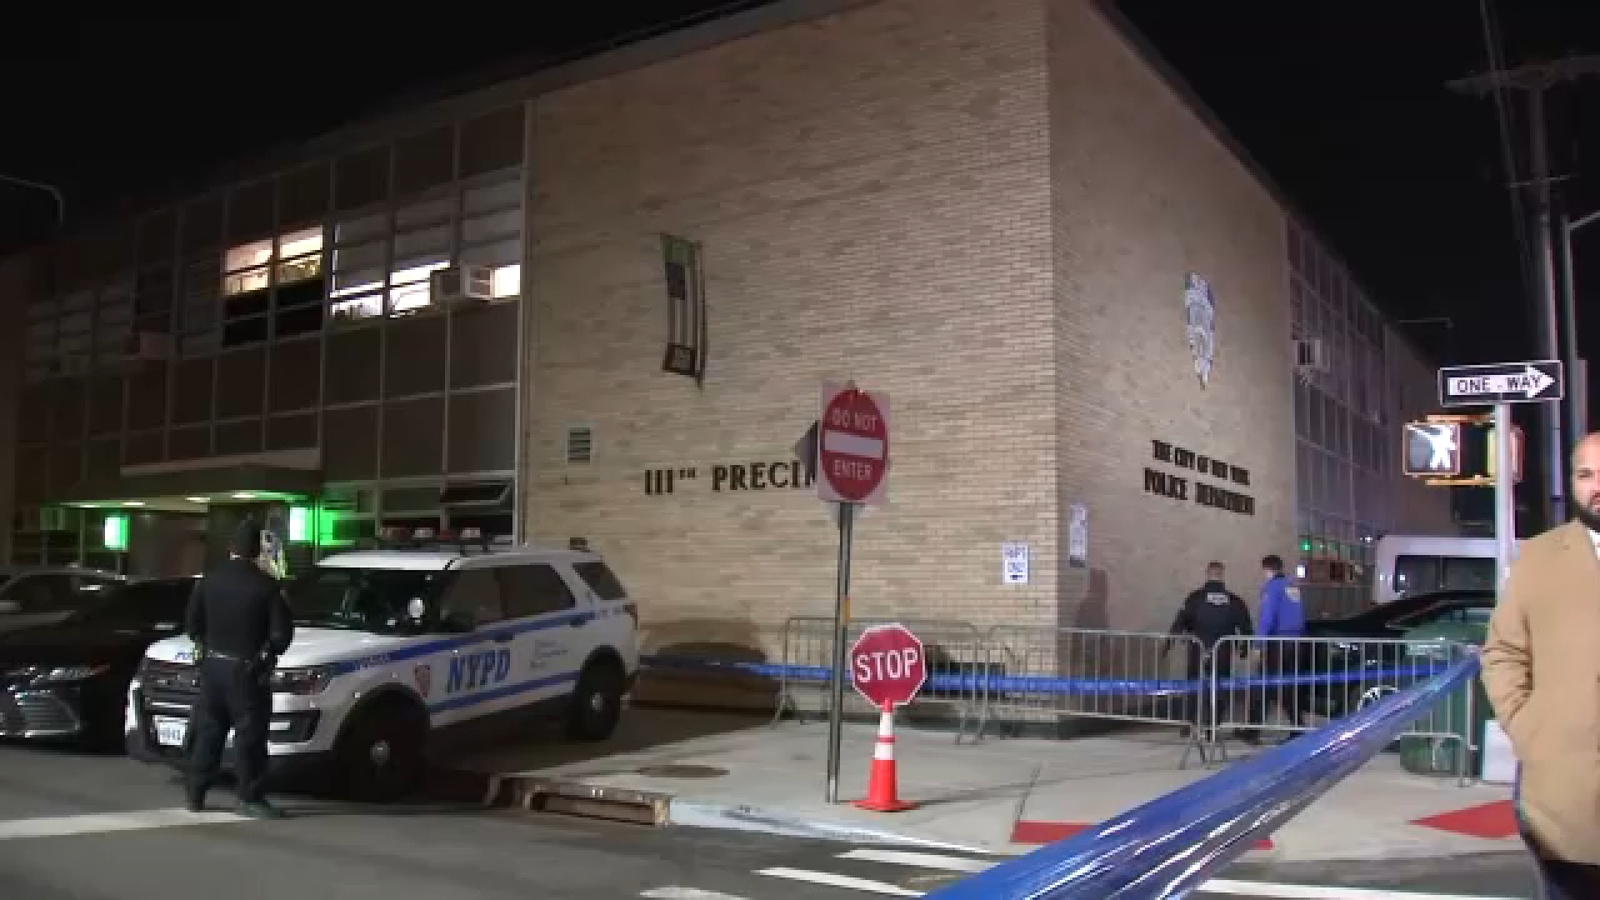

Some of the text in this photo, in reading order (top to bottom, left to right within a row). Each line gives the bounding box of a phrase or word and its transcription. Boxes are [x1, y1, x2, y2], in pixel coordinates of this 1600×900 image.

[1456, 374, 1541, 393] ONE WAY
[832, 407, 877, 431] DO NOT
[834, 459, 872, 481] ENTER
[1151, 440, 1172, 463] THE
[1174, 447, 1196, 470] CITY
[1197, 455, 1209, 474] OF
[1144, 467, 1188, 501] POLICE
[446, 647, 511, 694] NYPD
[856, 647, 919, 683] STOP
